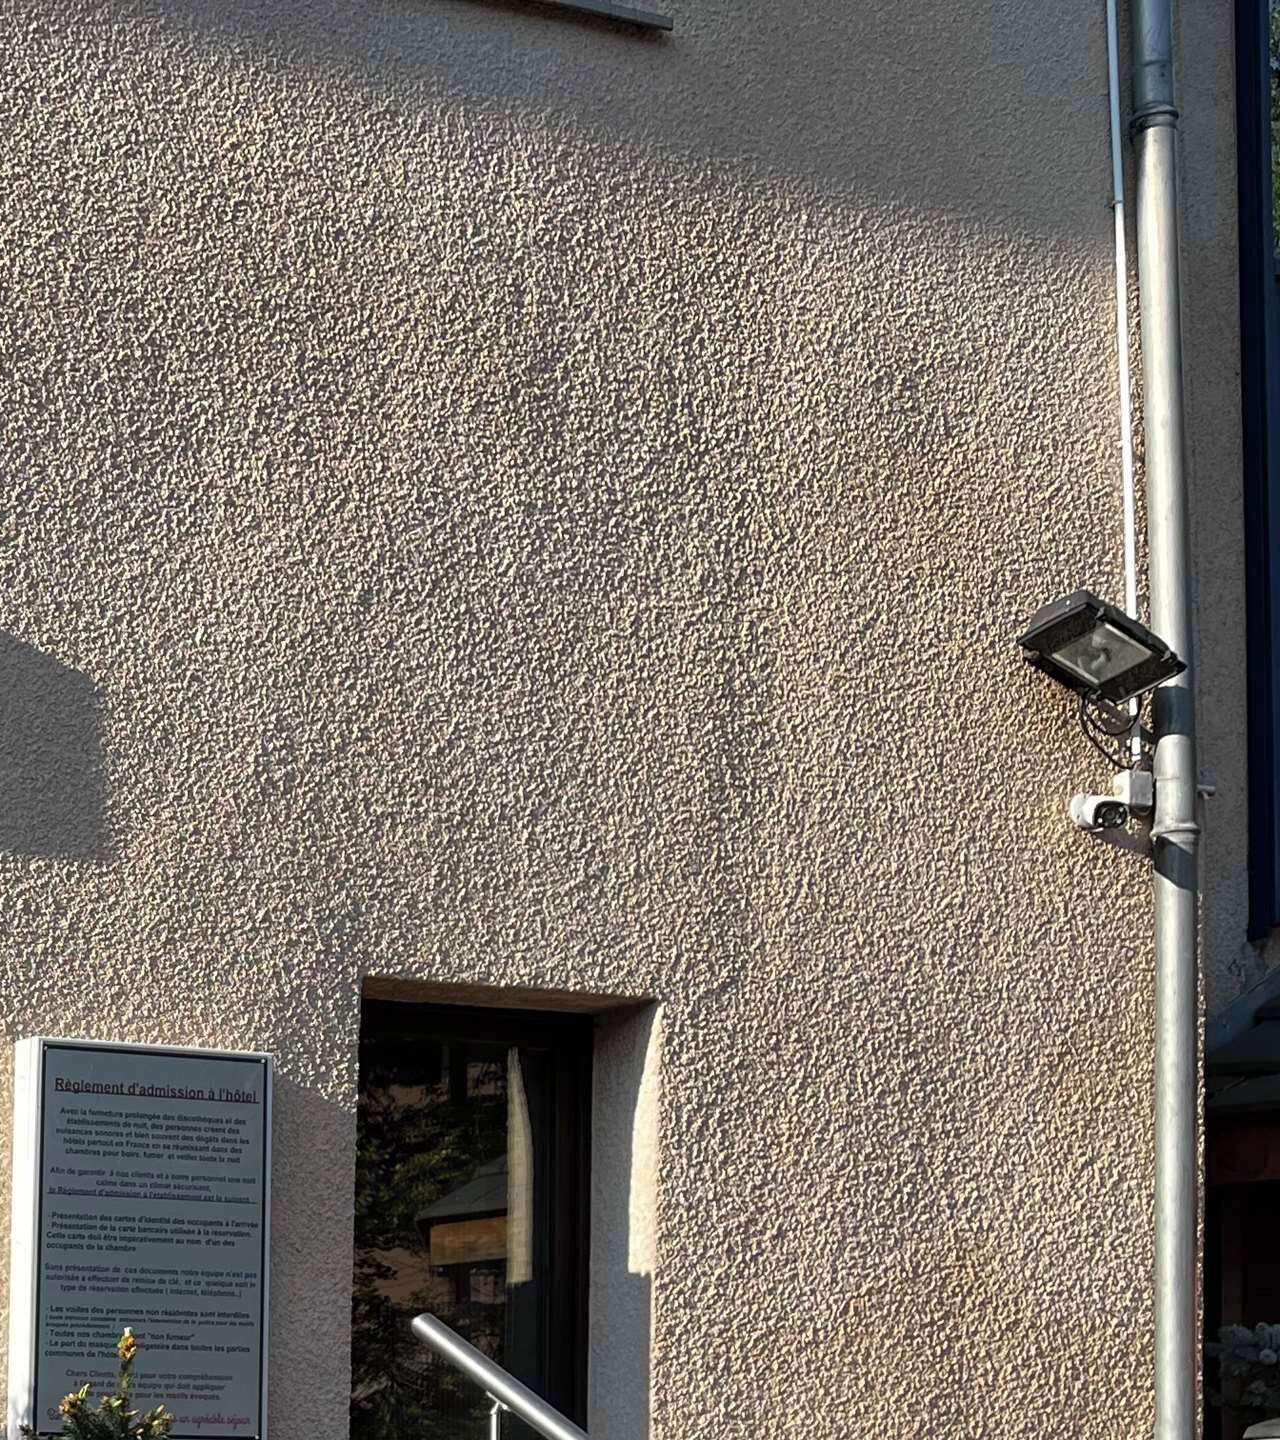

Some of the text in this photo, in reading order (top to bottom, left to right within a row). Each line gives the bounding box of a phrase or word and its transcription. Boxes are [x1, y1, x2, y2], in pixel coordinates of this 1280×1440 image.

[55, 1077, 123, 1096] Règlement
[128, 1082, 204, 1101] d'admission
[219, 1087, 256, 1104] l'hôtel
